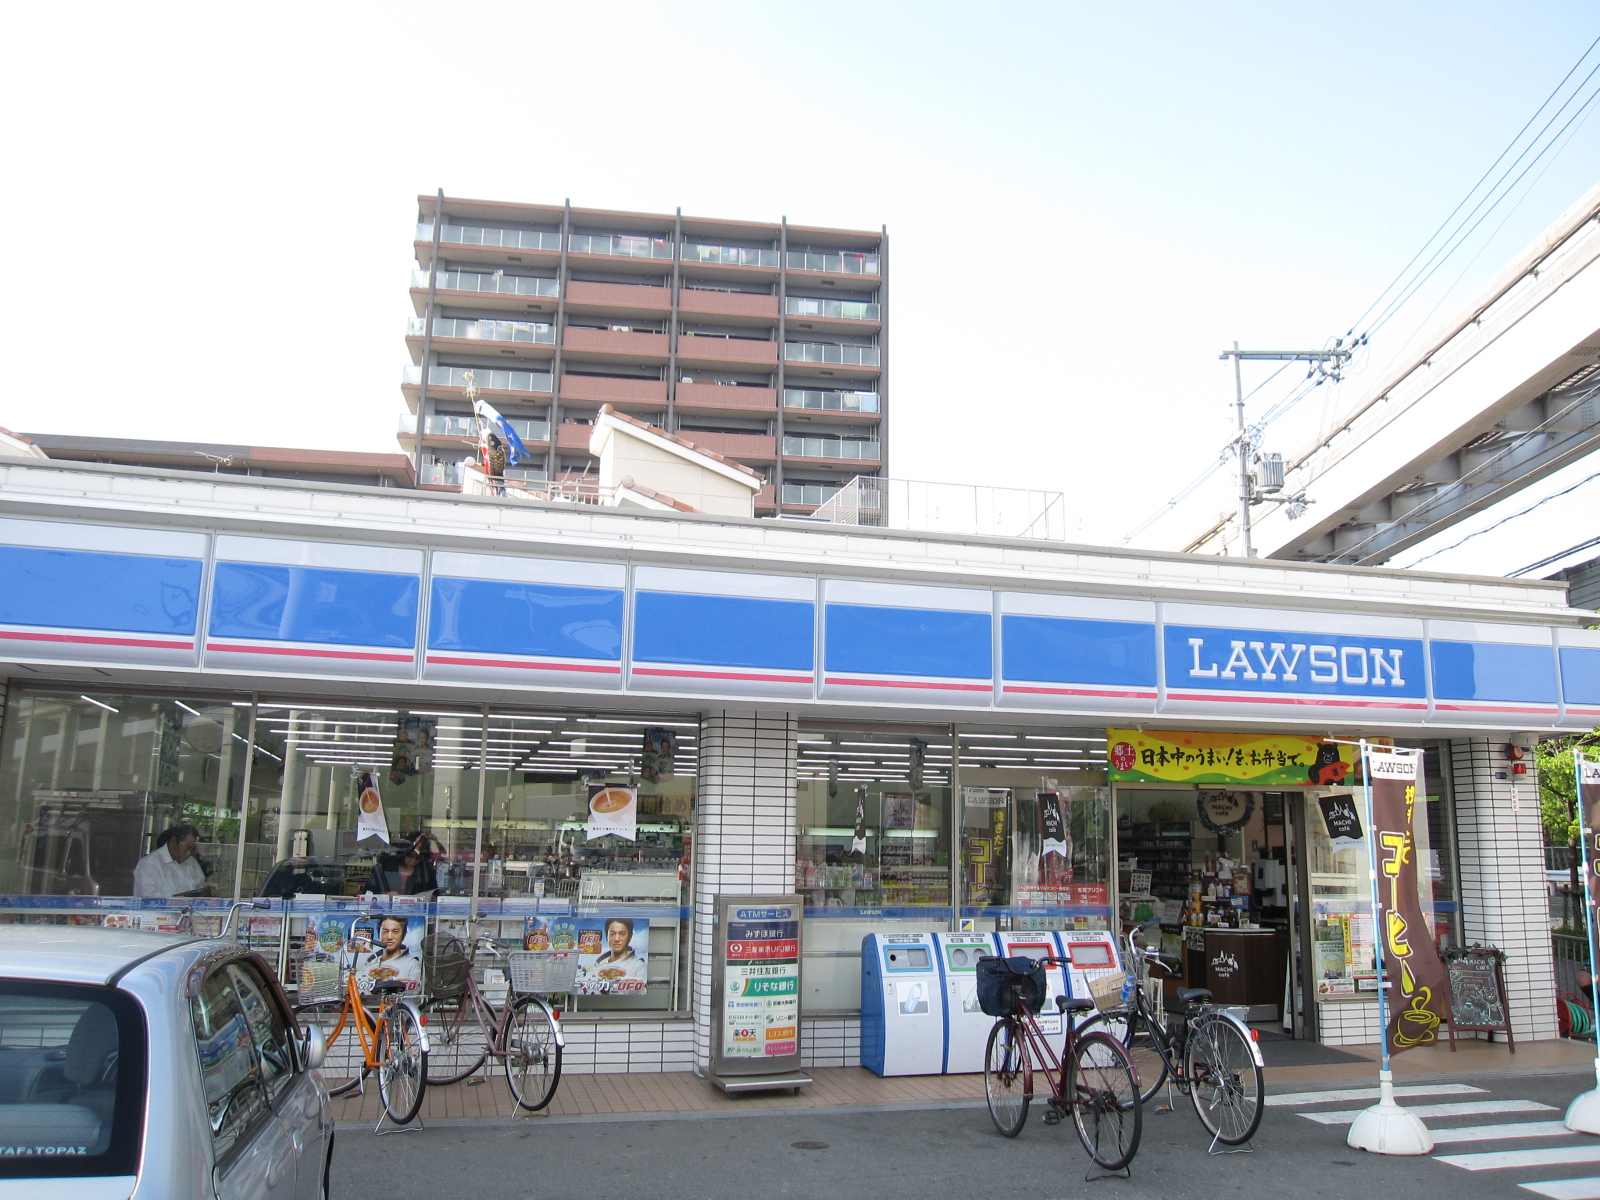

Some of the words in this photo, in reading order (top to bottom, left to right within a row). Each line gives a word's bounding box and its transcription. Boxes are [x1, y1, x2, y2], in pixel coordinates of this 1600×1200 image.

[1188, 638, 1405, 686] LAWSON
[1114, 745, 1135, 757] 郷土
[1141, 746, 1305, 767] 日本中のうまい!を、お弁当で。
[967, 796, 1005, 805] LAWSON
[993, 810, 1005, 857] 挽きたて
[740, 910, 789, 918] ATMサービス
[1380, 832, 1415, 996] コーヒー
[745, 929, 784, 938] みずほ銀行
[741, 967, 786, 976] 三井住友銀行
[754, 981, 794, 992] りそな銀行
[768, 1029, 793, 1037] じぶん銀行
